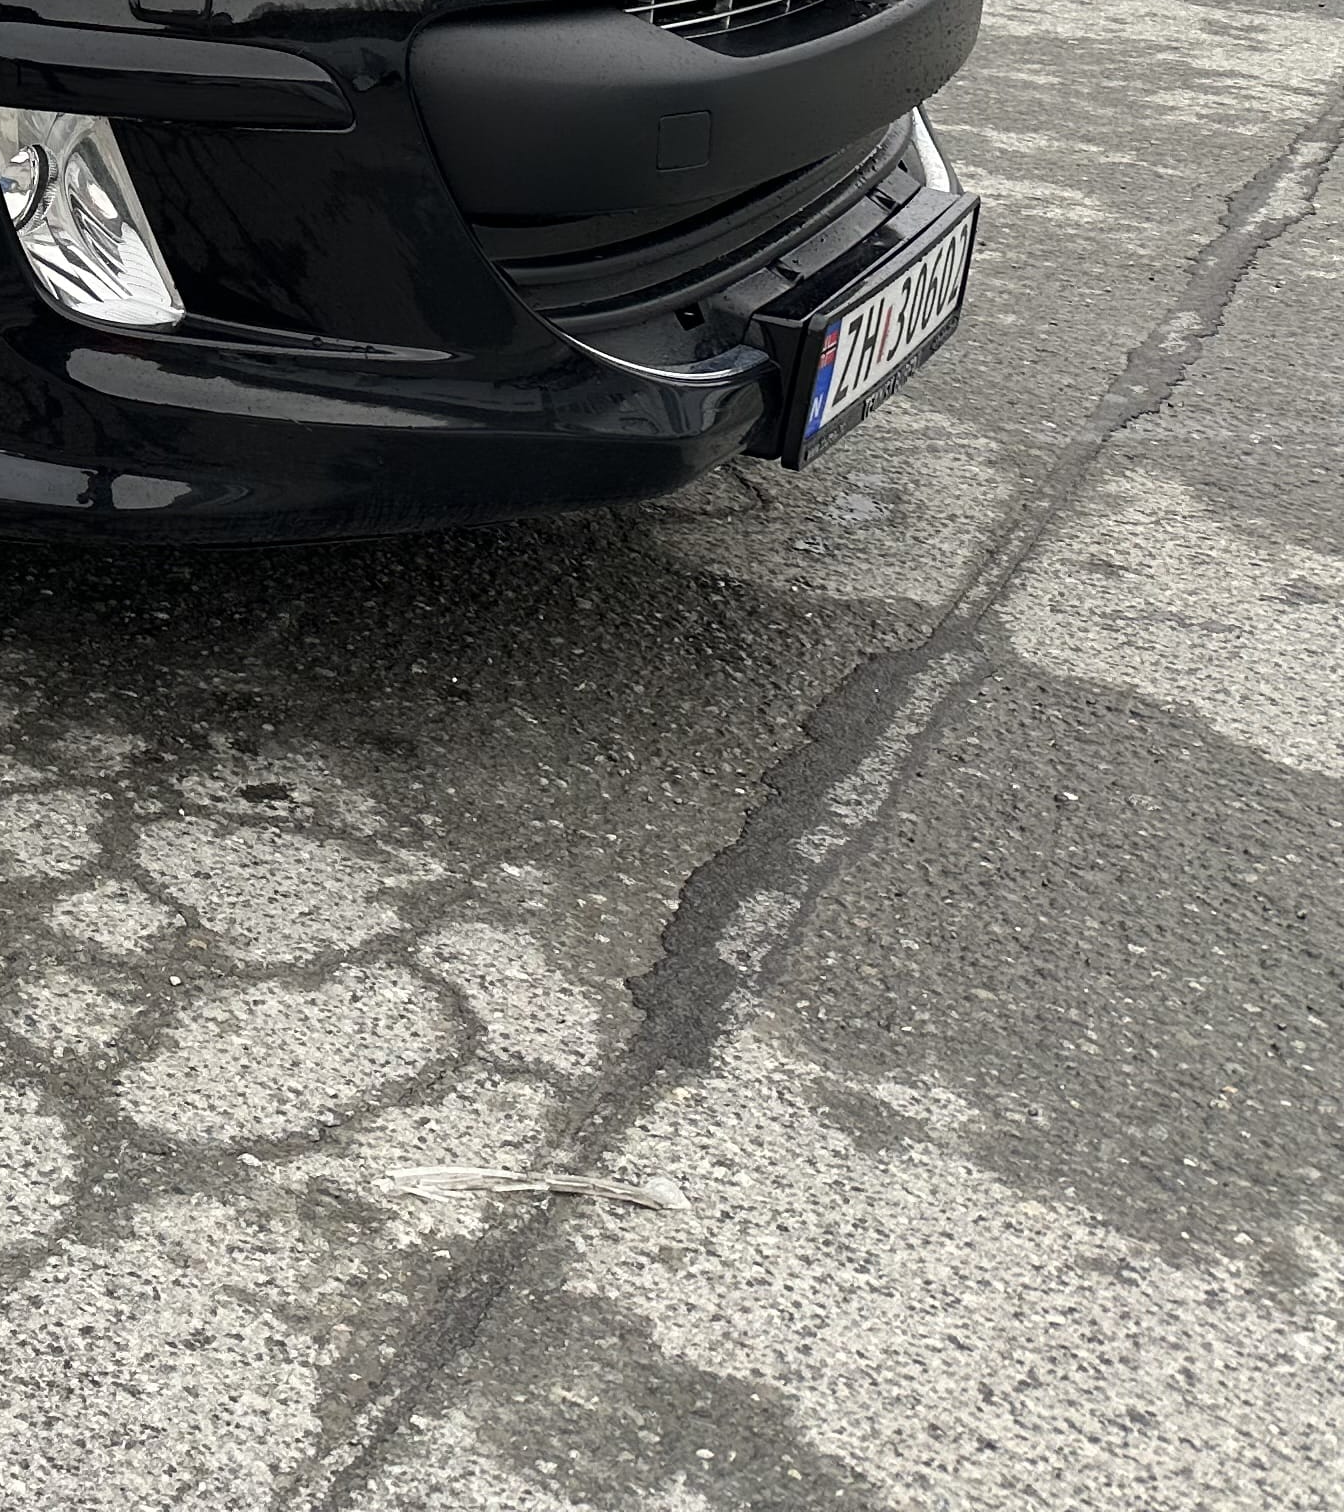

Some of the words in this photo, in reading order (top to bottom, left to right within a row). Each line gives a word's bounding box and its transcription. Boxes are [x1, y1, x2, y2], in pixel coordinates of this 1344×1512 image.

[831, 297, 885, 407] ZH
[886, 223, 968, 361] 30602
[809, 394, 824, 422] N
